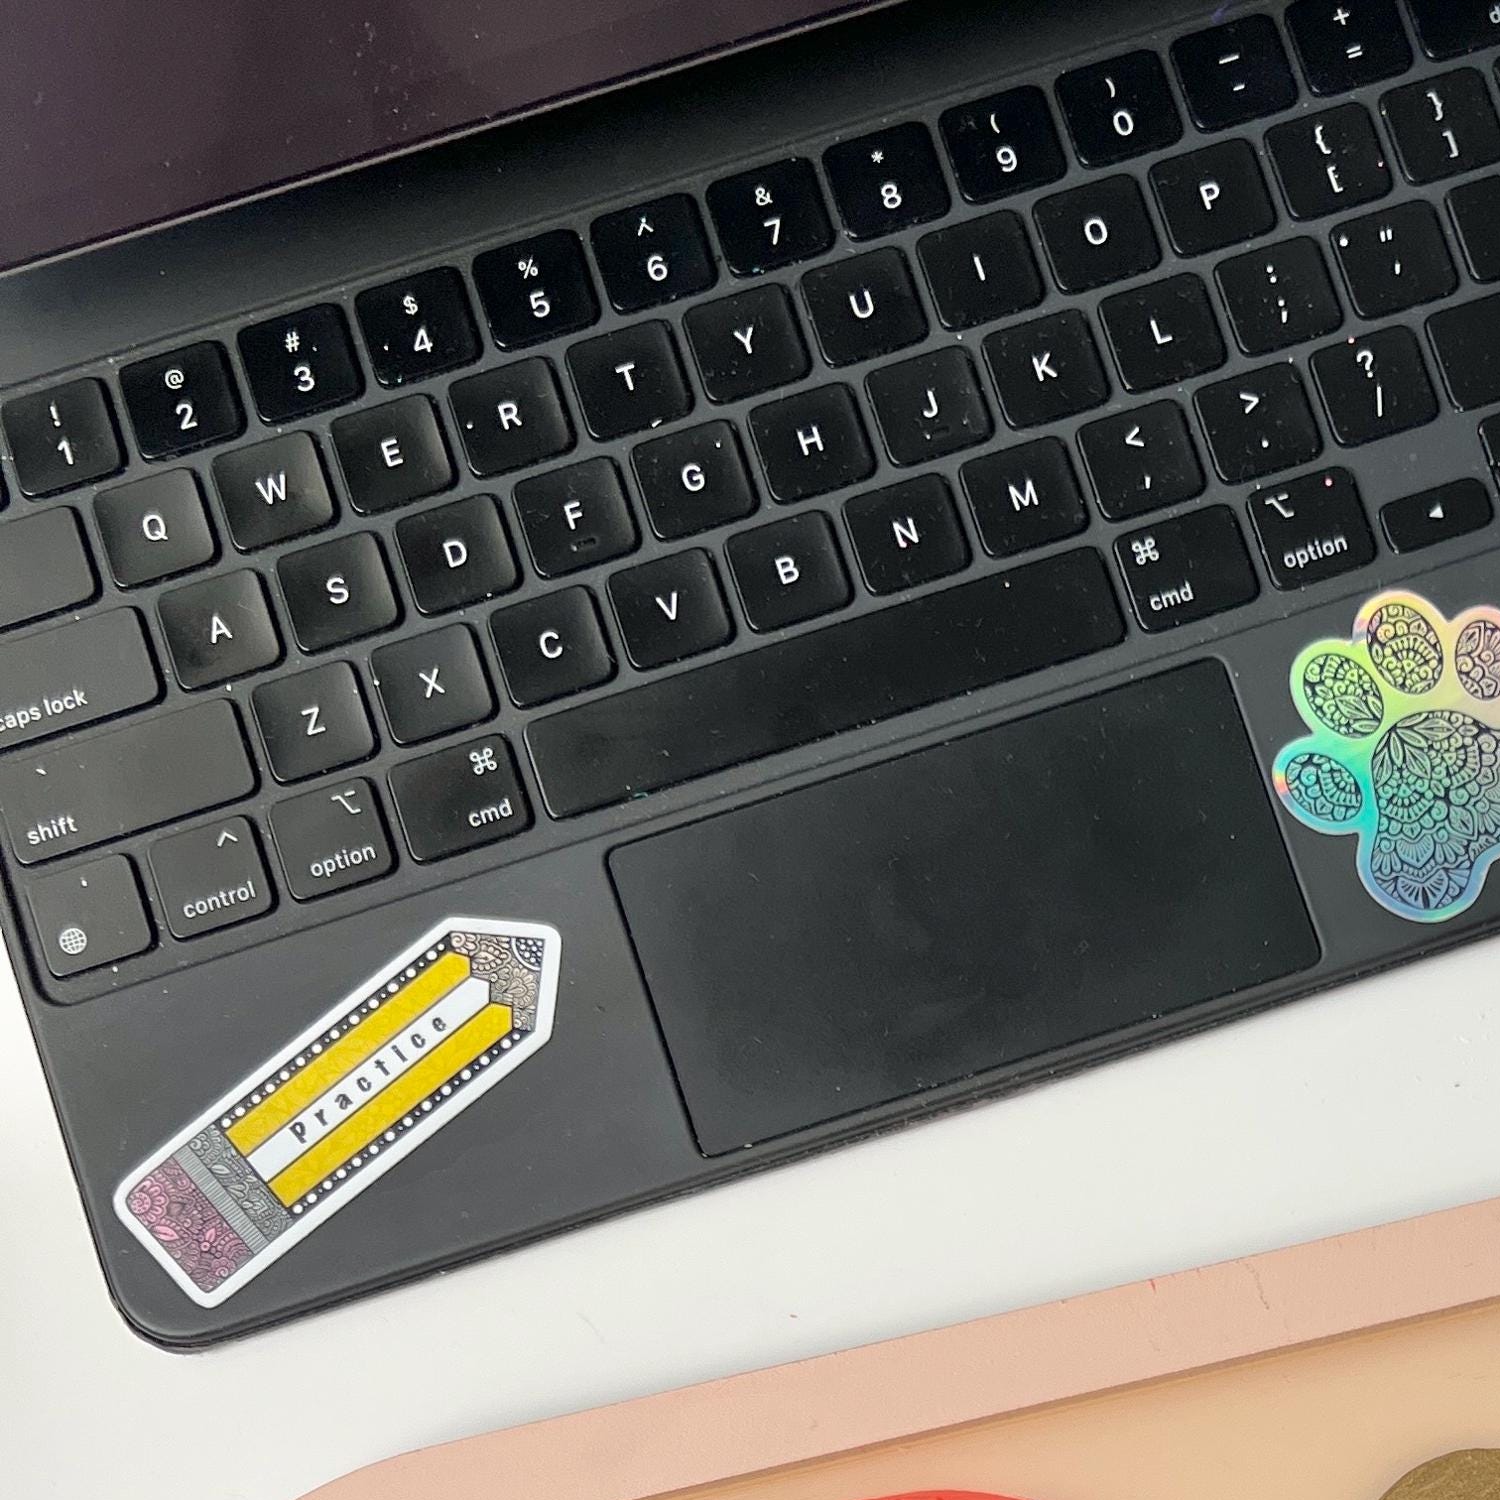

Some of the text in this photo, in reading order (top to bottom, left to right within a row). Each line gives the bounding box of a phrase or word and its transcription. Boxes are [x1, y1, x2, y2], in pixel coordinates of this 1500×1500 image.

[1333, 8, 1350, 26] +
[1346, 45, 1363, 59] =
[1112, 110, 1134, 136] 0
[996, 146, 1018, 173] 9
[754, 186, 774, 206] &
[880, 183, 902, 209] 8
[1199, 182, 1220, 210] P
[763, 217, 781, 246] 7
[1084, 217, 1108, 245] O
[517, 258, 539, 280] %
[647, 255, 668, 282] 6
[402, 295, 419, 316] $
[529, 290, 551, 318] 5
[849, 290, 874, 319] U
[284, 331, 300, 353] #
[413, 327, 434, 353] 4
[733, 326, 754, 354] Y
[1150, 319, 1173, 345] L
[614, 362, 635, 391] T
[1032, 352, 1058, 382] K
[1356, 349, 1374, 378] ?
[164, 369, 185, 390] @
[293, 365, 315, 392] 3
[49, 405, 61, 427] !
[175, 403, 198, 430] 2
[497, 401, 523, 430] R
[923, 390, 938, 418] J
[57, 439, 74, 465] 1
[380, 438, 404, 467] E
[796, 425, 824, 456] H
[254, 473, 286, 505] W
[681, 463, 705, 492] G
[1008, 479, 1039, 511] M
[142, 514, 169, 541] Q
[563, 501, 583, 530] F
[892, 517, 919, 548] N
[442, 539, 468, 568] D
[1283, 536, 1348, 569] option
[774, 556, 800, 585] B
[326, 576, 349, 604] S
[1150, 580, 1194, 611] cmd
[655, 591, 678, 621] V
[211, 615, 233, 644] A
[539, 630, 563, 659] C
[418, 667, 446, 698] X
[42, 689, 88, 716] lock
[301, 705, 326, 736] Z
[468, 797, 513, 827] cmd
[27, 815, 78, 845] shift
[310, 846, 376, 877] option
[183, 880, 256, 918] control
